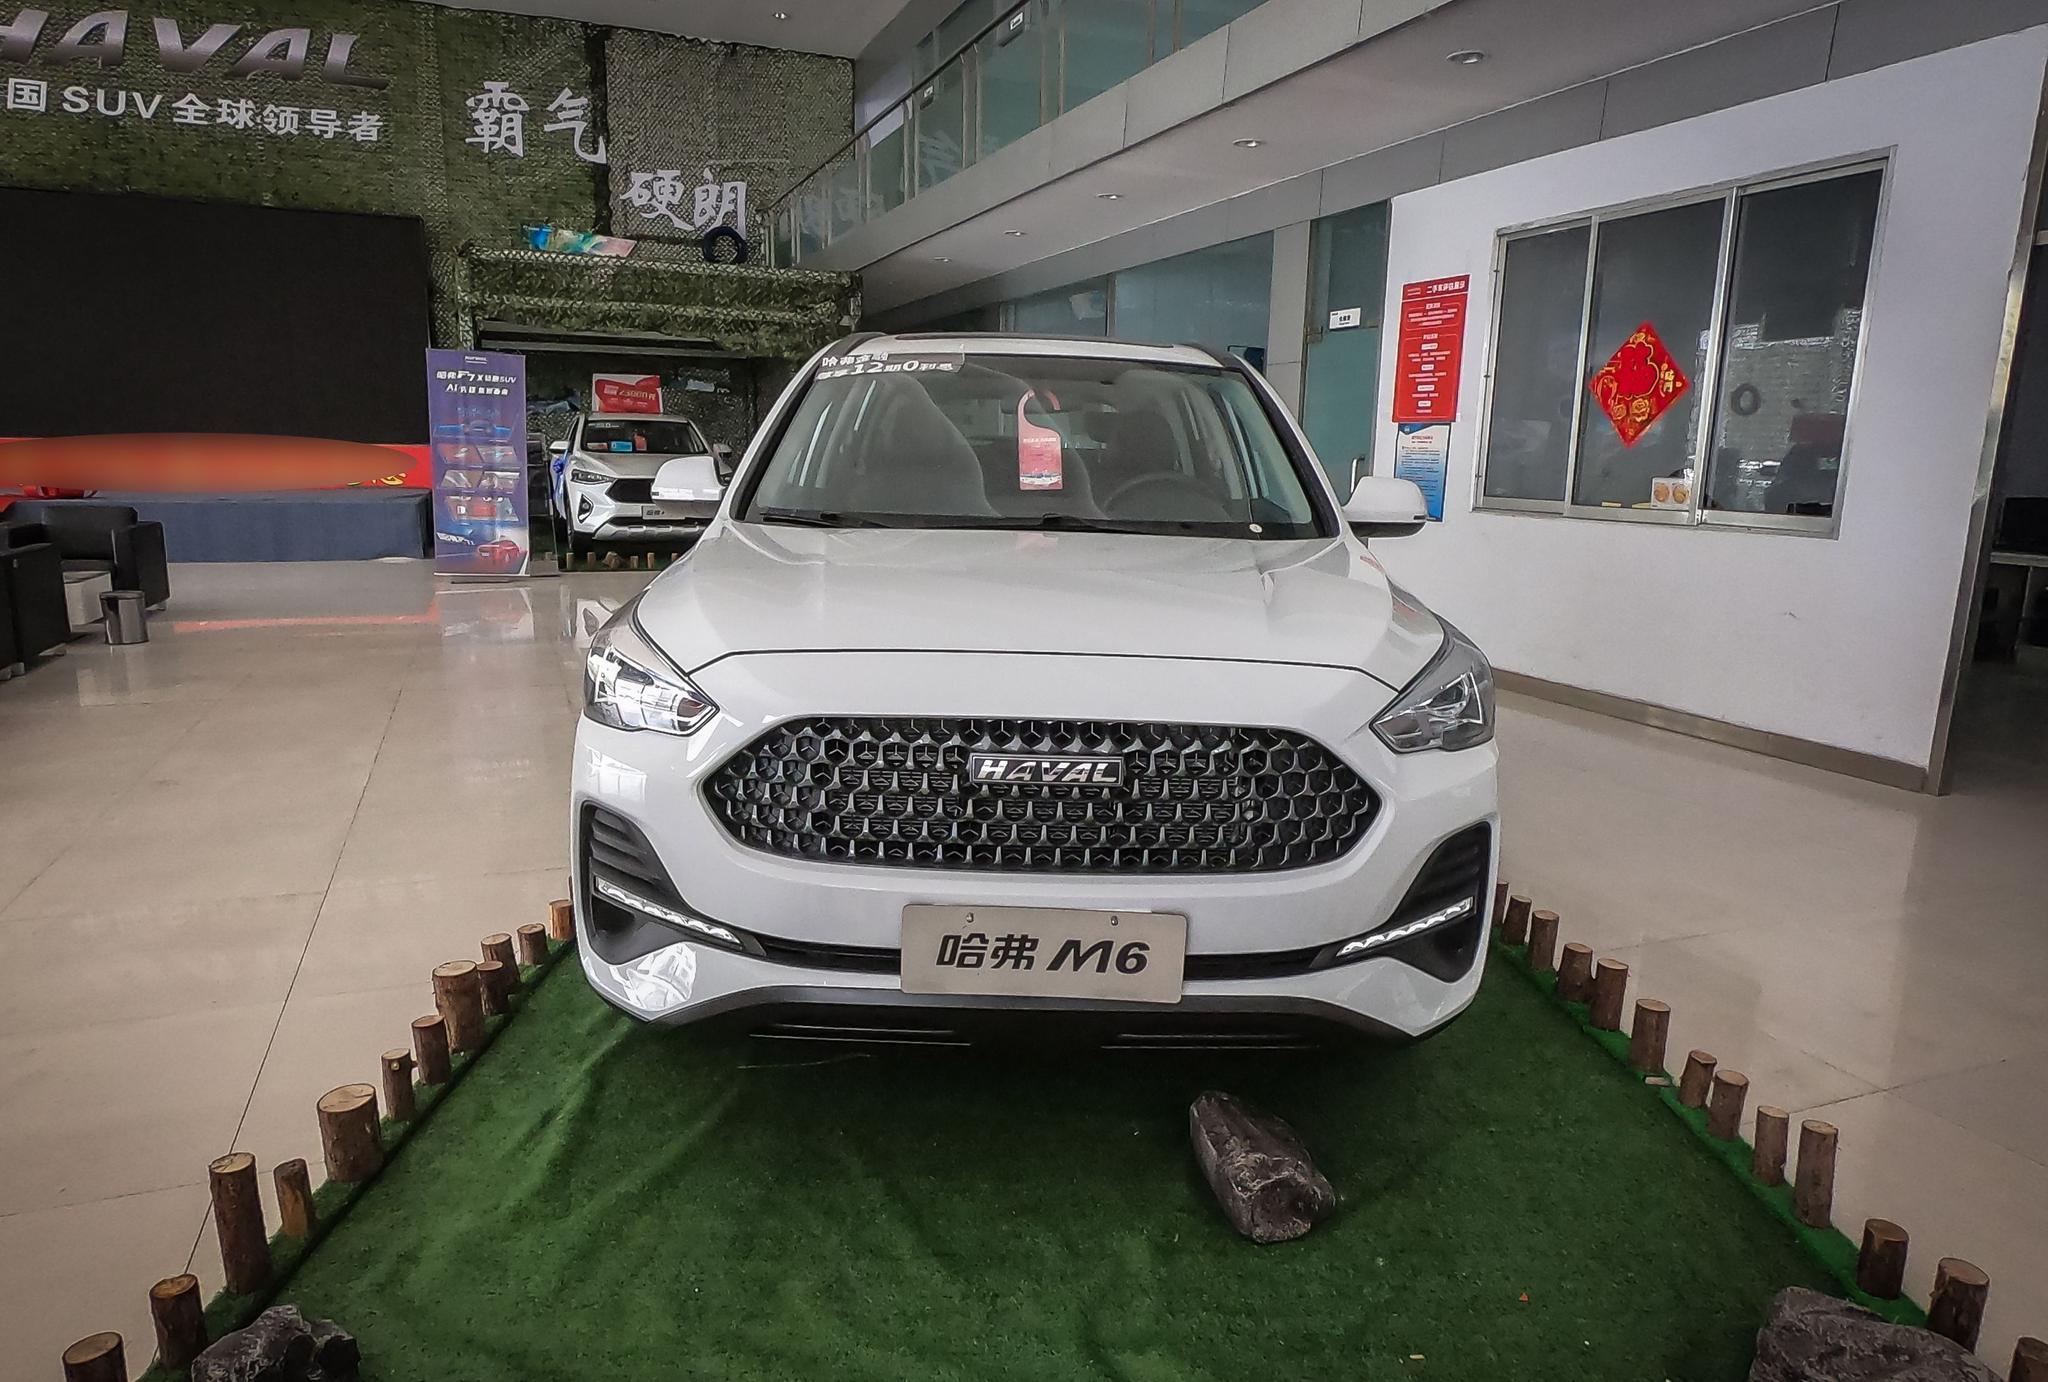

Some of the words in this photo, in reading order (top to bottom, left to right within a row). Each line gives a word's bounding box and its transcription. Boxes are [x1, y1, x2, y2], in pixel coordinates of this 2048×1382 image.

[0, 9, 390, 90] HAVAL
[465, 81, 607, 164] 霸气
[620, 167, 747, 240] 硬朗
[977, 759, 1117, 783] HAVAL
[935, 932, 1040, 971] 哈弗
[1046, 938, 1151, 975] M6
